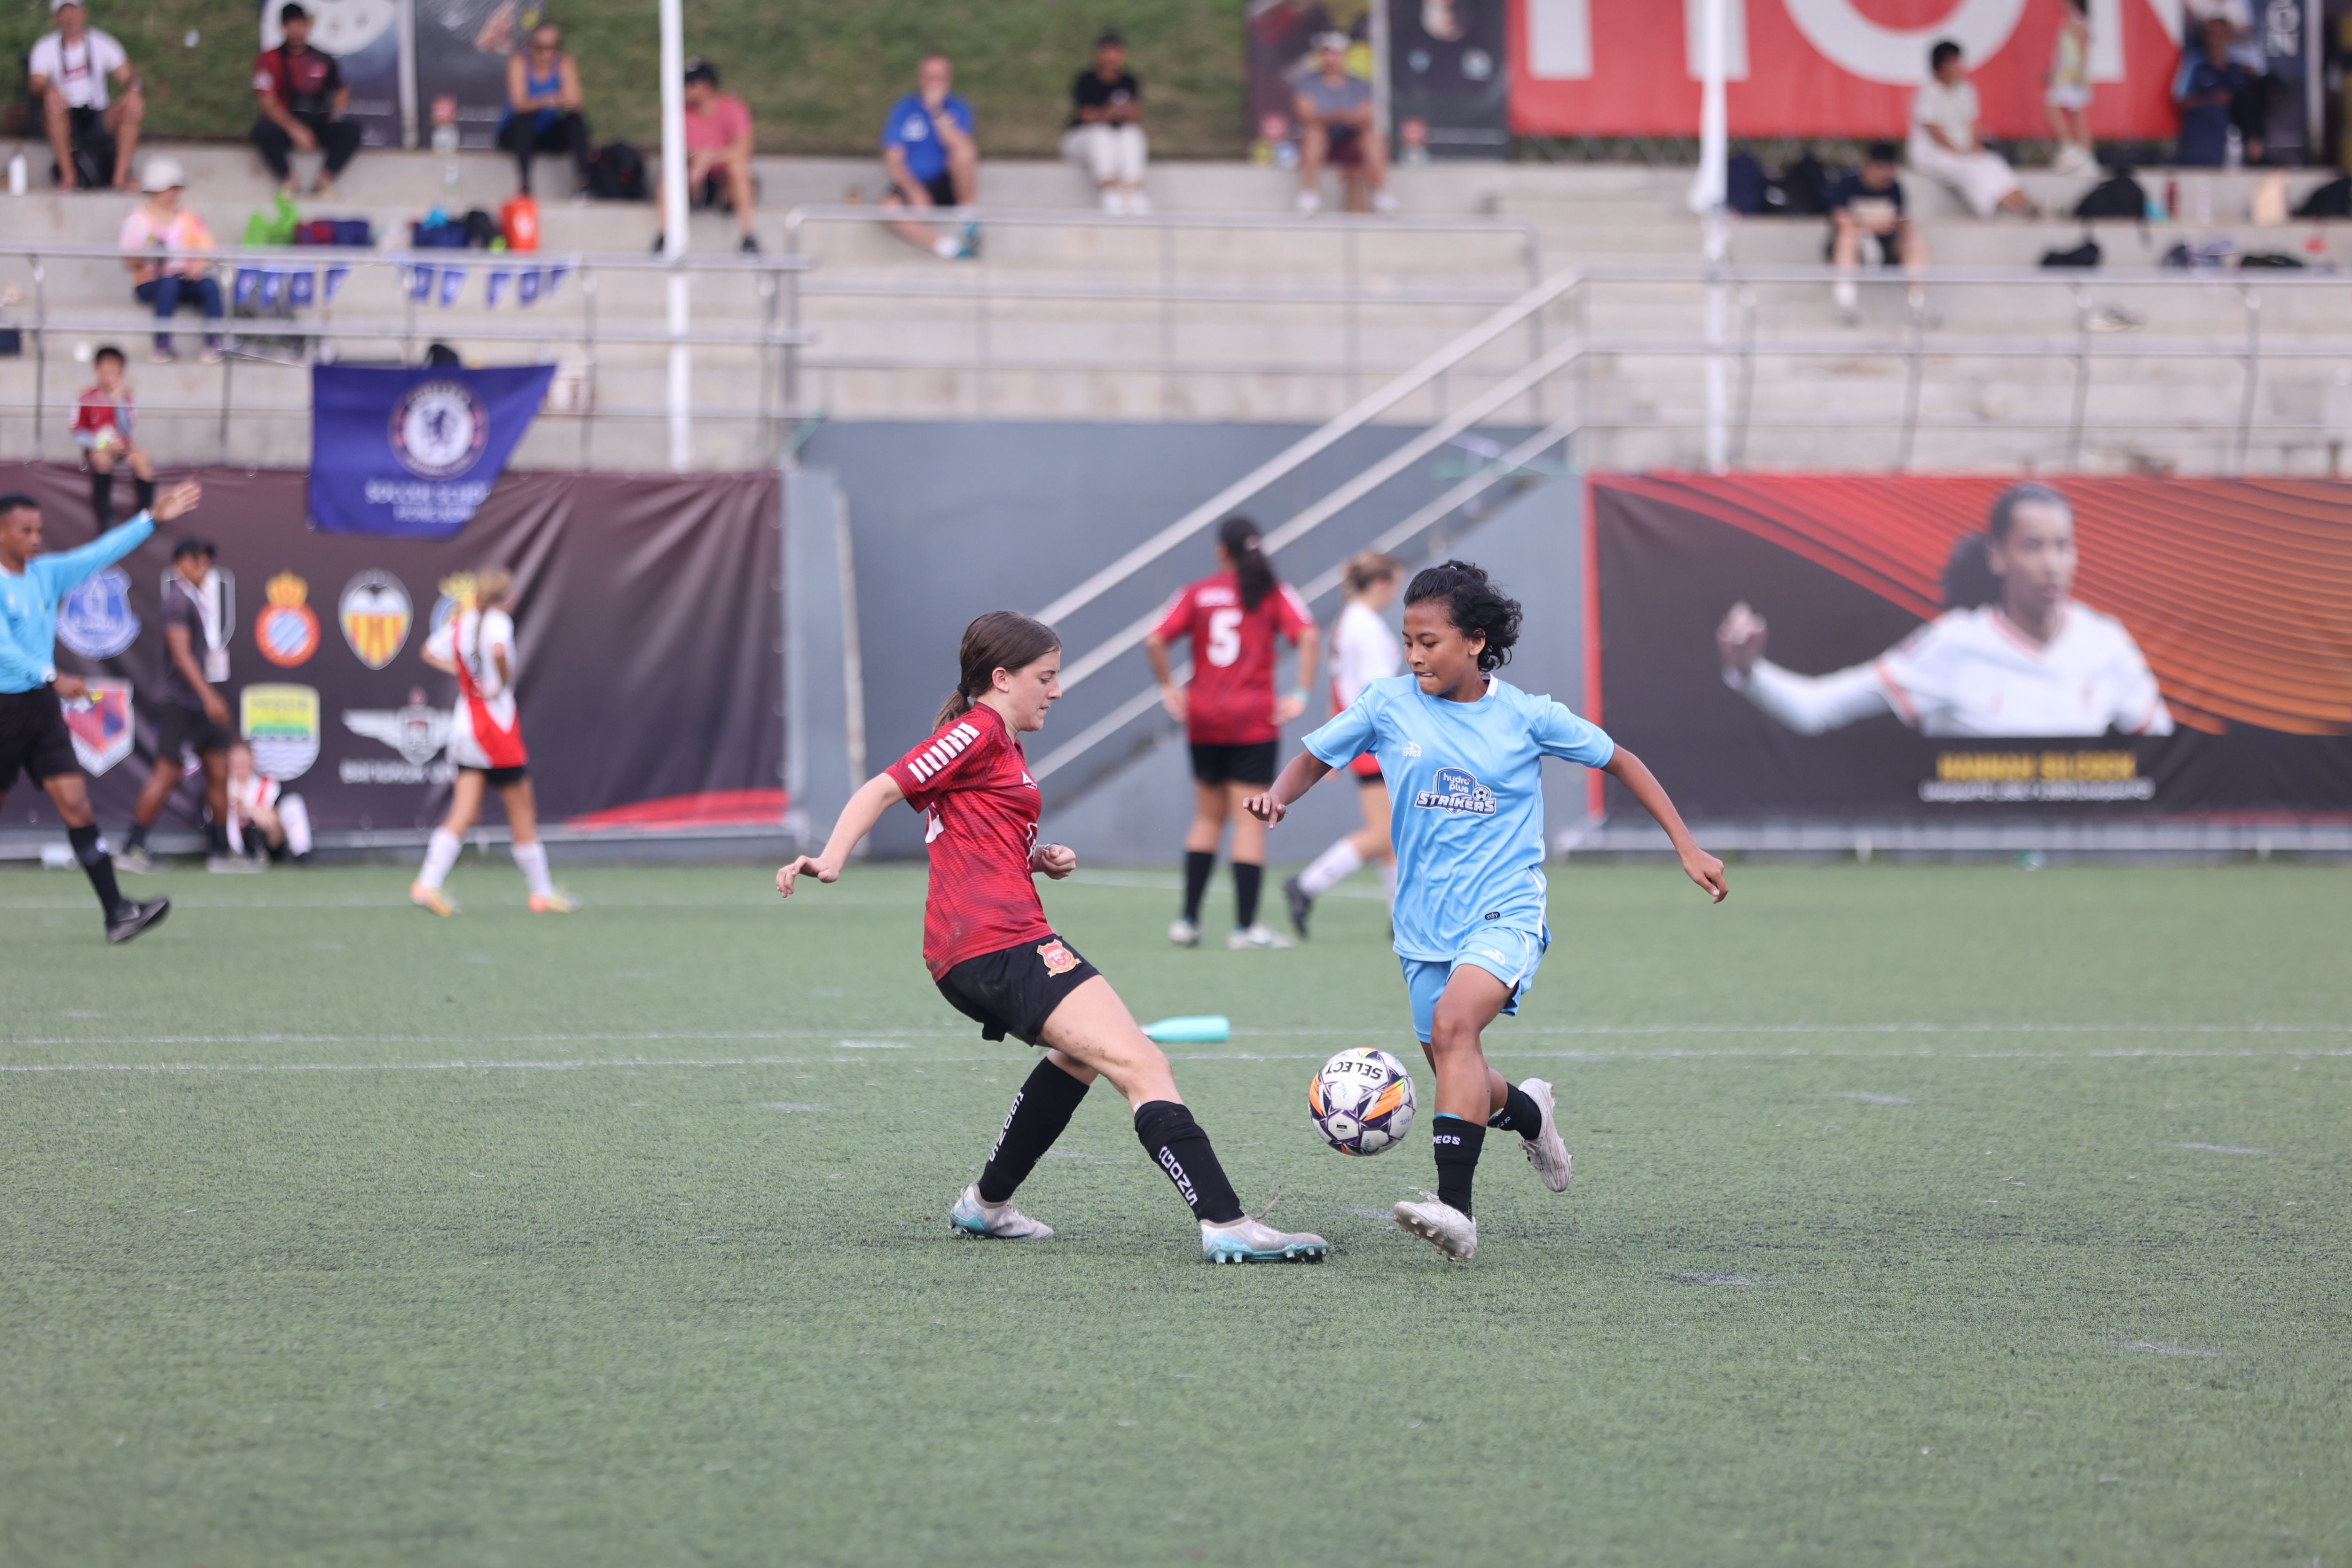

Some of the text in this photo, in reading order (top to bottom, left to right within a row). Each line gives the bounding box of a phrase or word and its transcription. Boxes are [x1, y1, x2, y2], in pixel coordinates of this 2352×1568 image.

[1206, 608, 1243, 668] 5
[1443, 773, 1471, 785] hydro
[1449, 783, 1469, 793] plus
[1418, 792, 1495, 813] STRIKERS
[1325, 1061, 1383, 1080] SELECT
